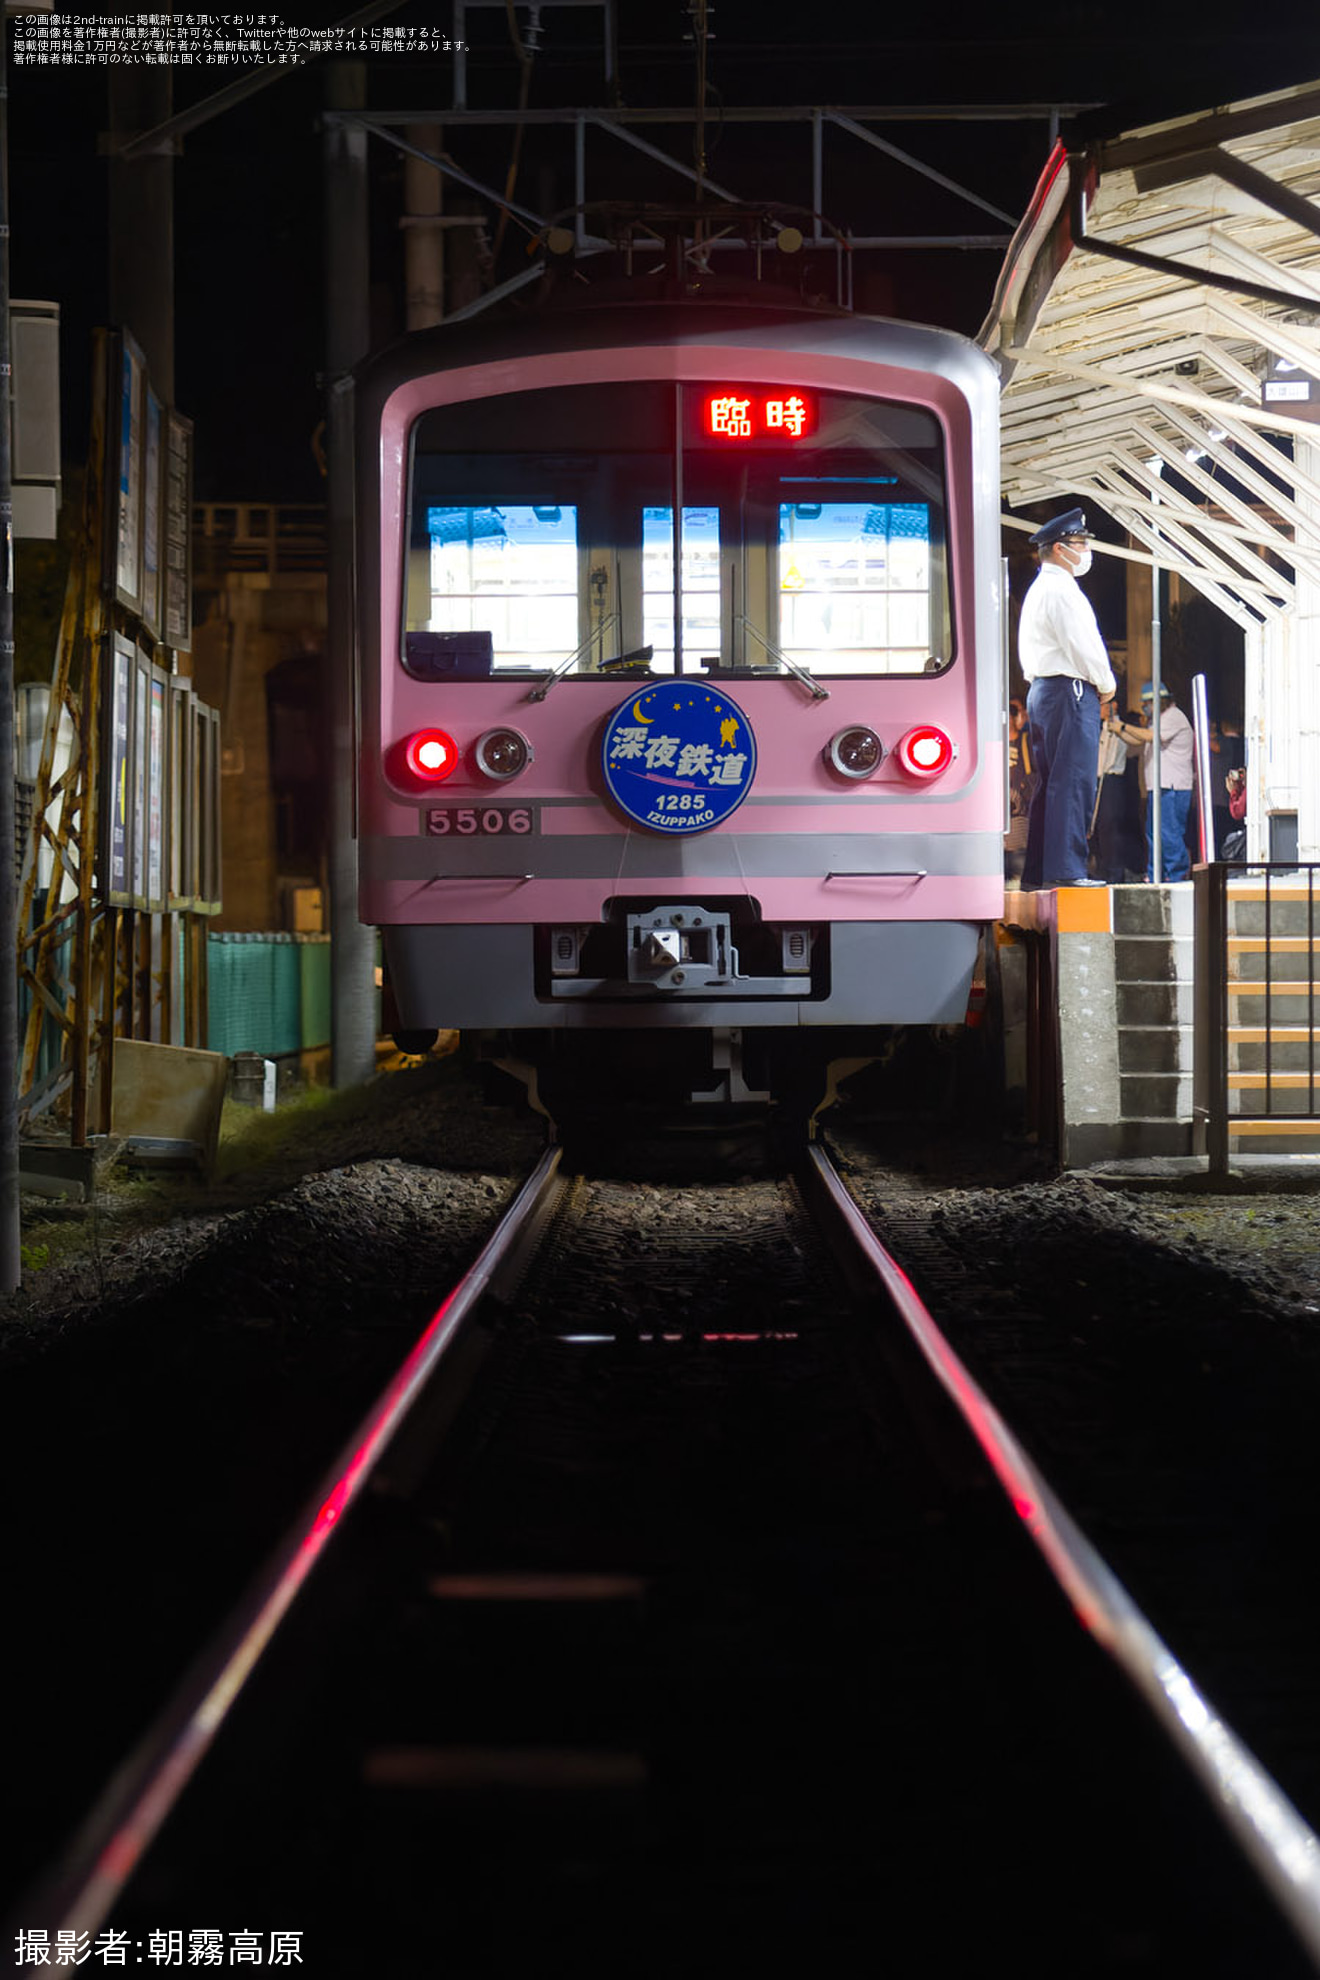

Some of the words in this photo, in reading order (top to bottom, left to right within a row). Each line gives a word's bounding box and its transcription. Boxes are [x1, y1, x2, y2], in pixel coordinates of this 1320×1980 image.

[710, 396, 806, 436] 臨時
[609, 727, 748, 786] 深夜鉄道
[656, 794, 706, 811] 1285
[428, 808, 531, 835] 5506
[646, 808, 715, 827] IZUPPAKO
